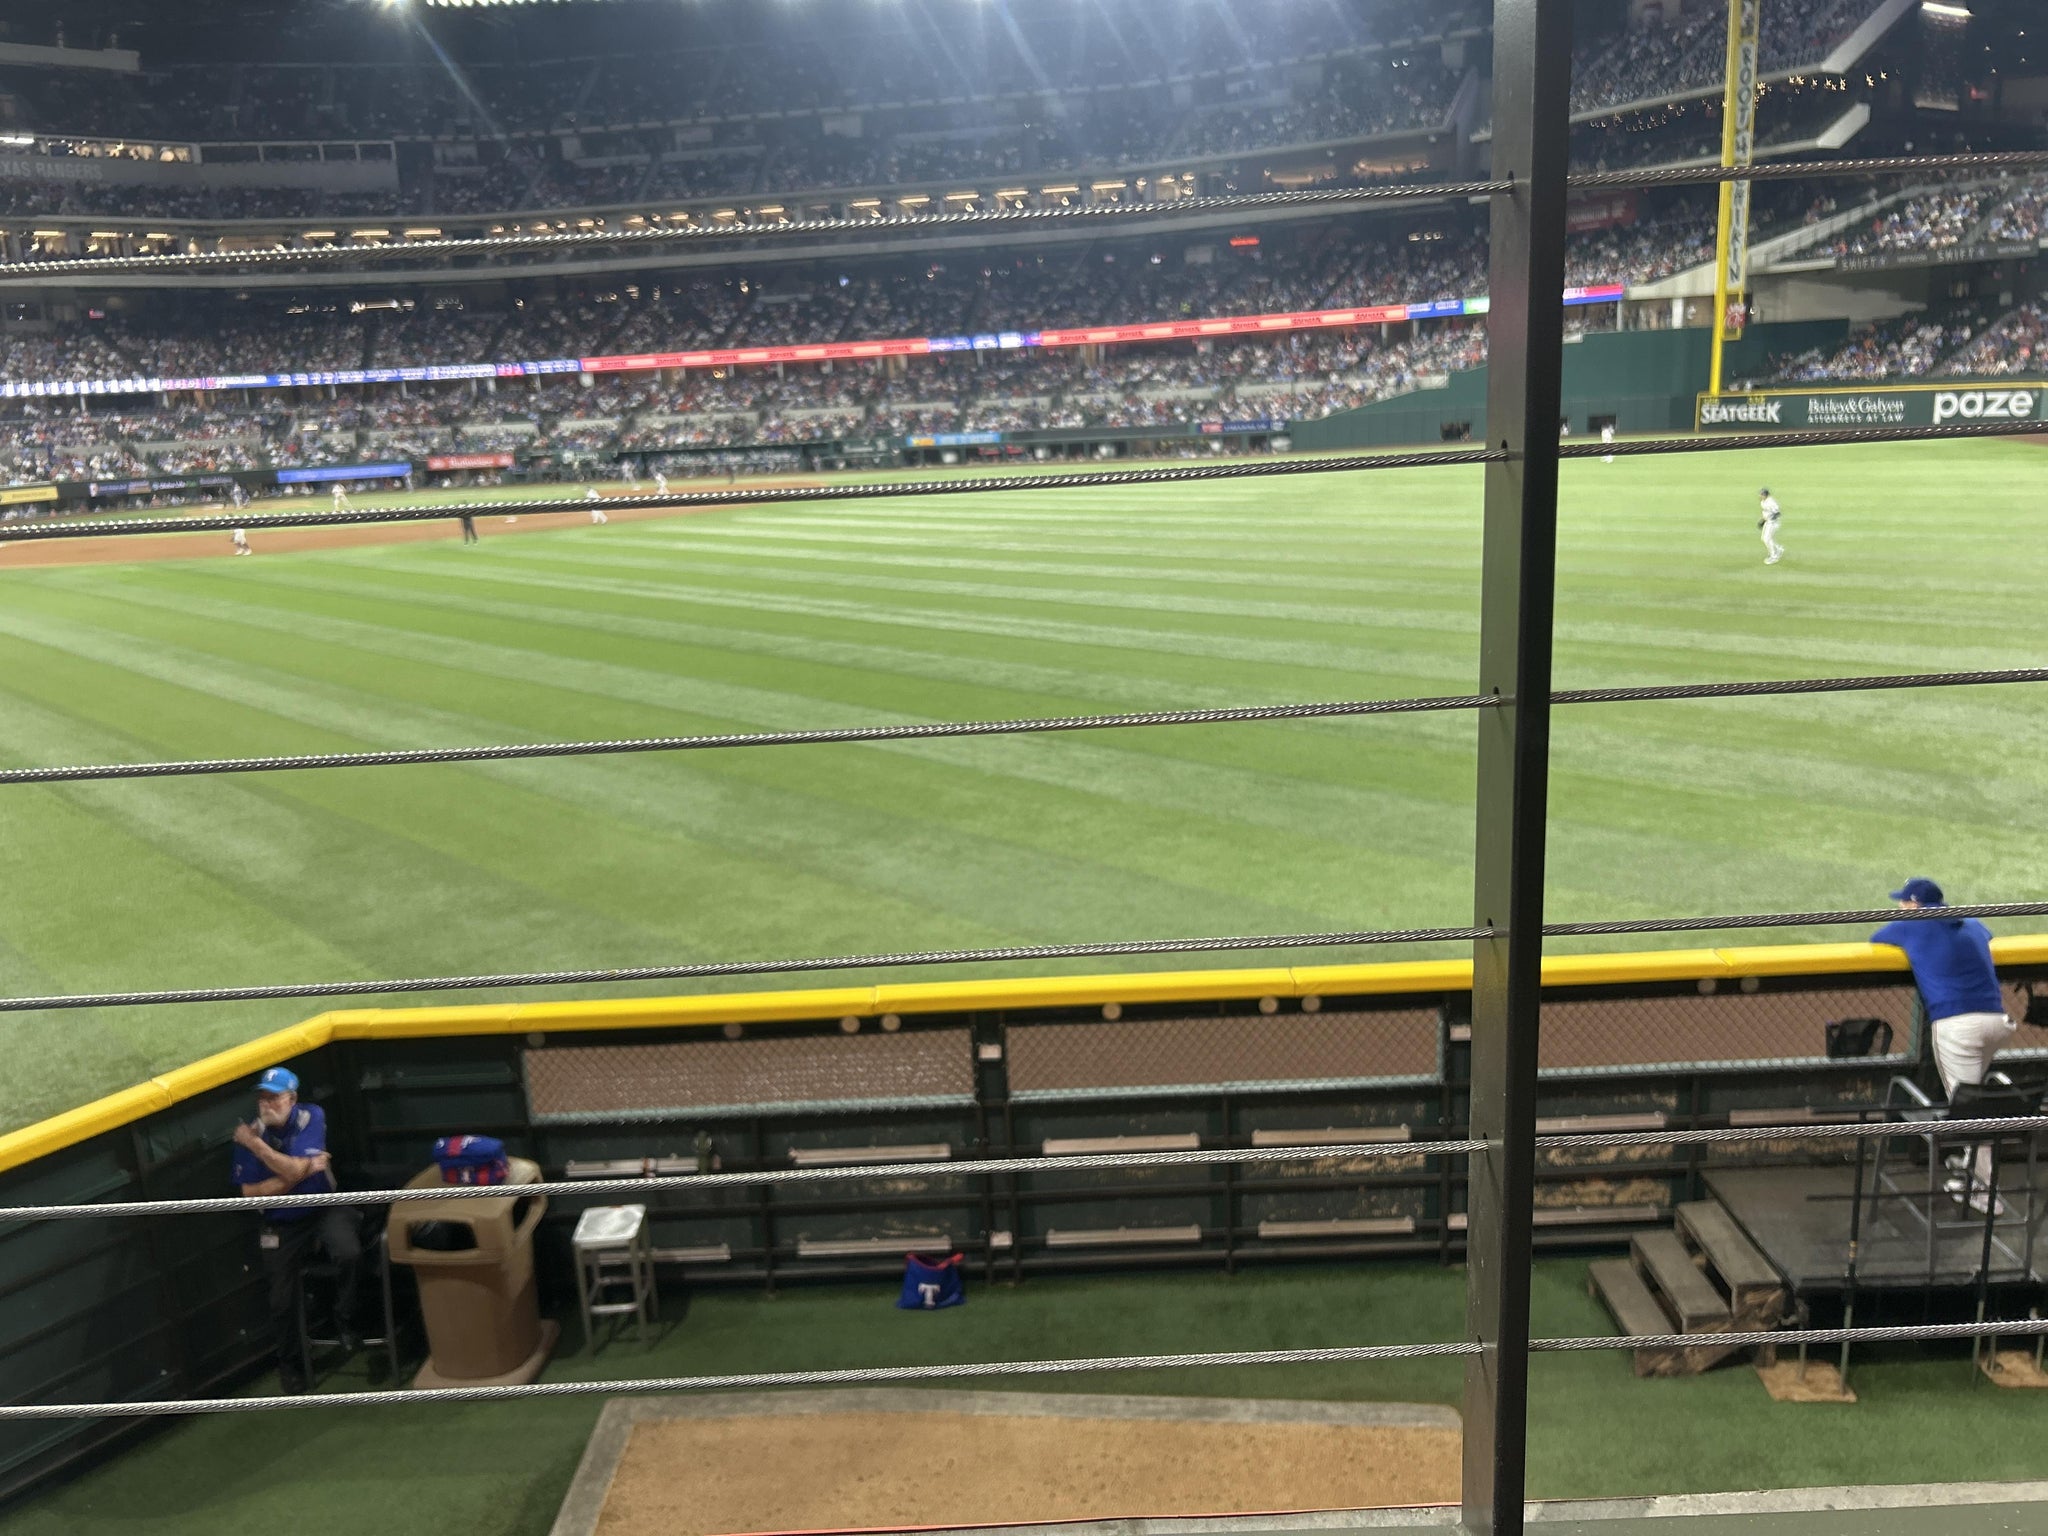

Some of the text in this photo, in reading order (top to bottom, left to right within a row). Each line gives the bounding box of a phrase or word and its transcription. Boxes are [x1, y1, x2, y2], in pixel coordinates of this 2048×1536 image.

[0, 161, 103, 180] XAS RANGERS
[1701, 401, 1781, 424] SEATGEEK
[1807, 413, 1862, 424] ATTORNEYS
[1881, 412, 1904, 423] LAW
[1933, 390, 2034, 424] paze
[918, 1283, 941, 1307] T
